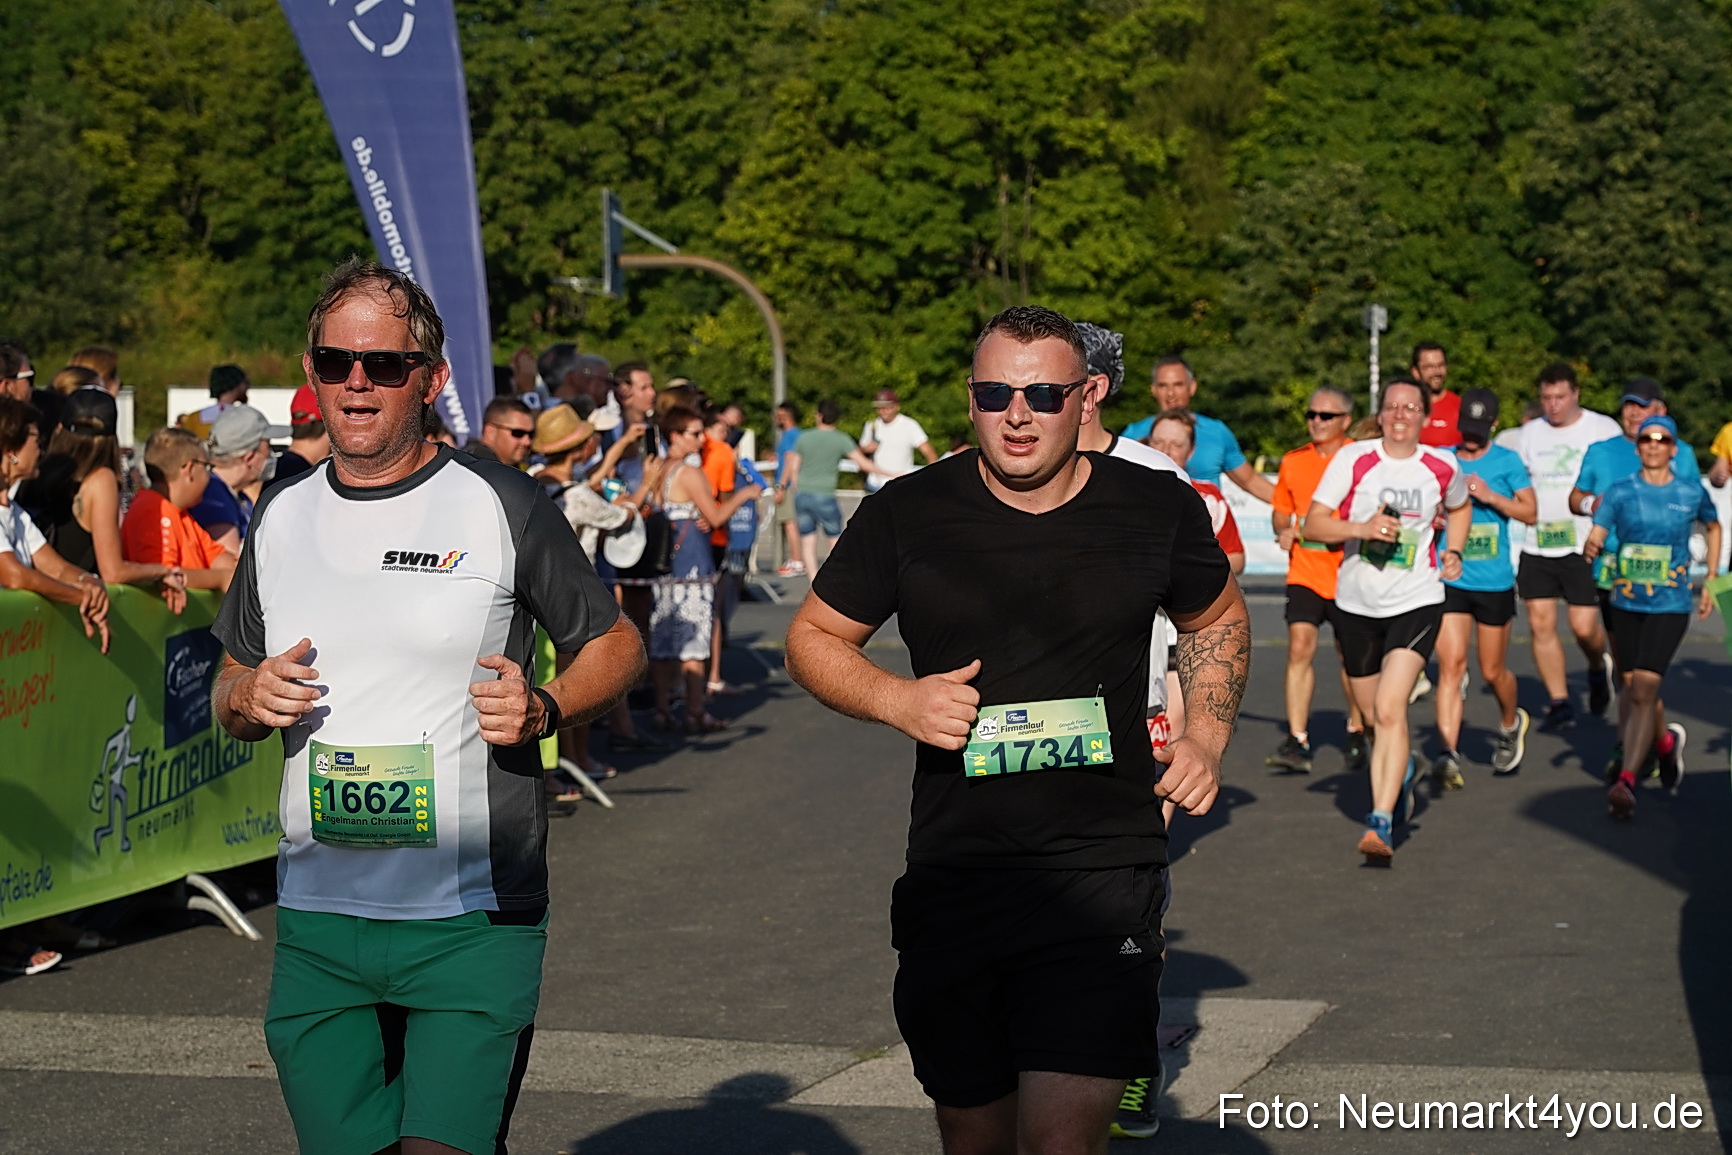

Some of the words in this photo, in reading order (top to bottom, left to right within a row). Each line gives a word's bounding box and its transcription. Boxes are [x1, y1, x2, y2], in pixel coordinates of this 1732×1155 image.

[382, 550, 440, 567] swn
[381, 564, 419, 573] stadtwerke
[1000, 720, 1044, 733] Firmenlauf
[1018, 727, 1044, 736] neumarkt
[990, 735, 1088, 774] 1734
[330, 763, 371, 773] Firmenlauf
[323, 779, 411, 814] 1662
[314, 787, 322, 822] RUN
[415, 785, 429, 832] 2022
[138, 797, 195, 841] neumarkt
[322, 813, 368, 825] Engelmann
[370, 816, 415, 826] Christian
[1119, 947, 1142, 955] adidas
